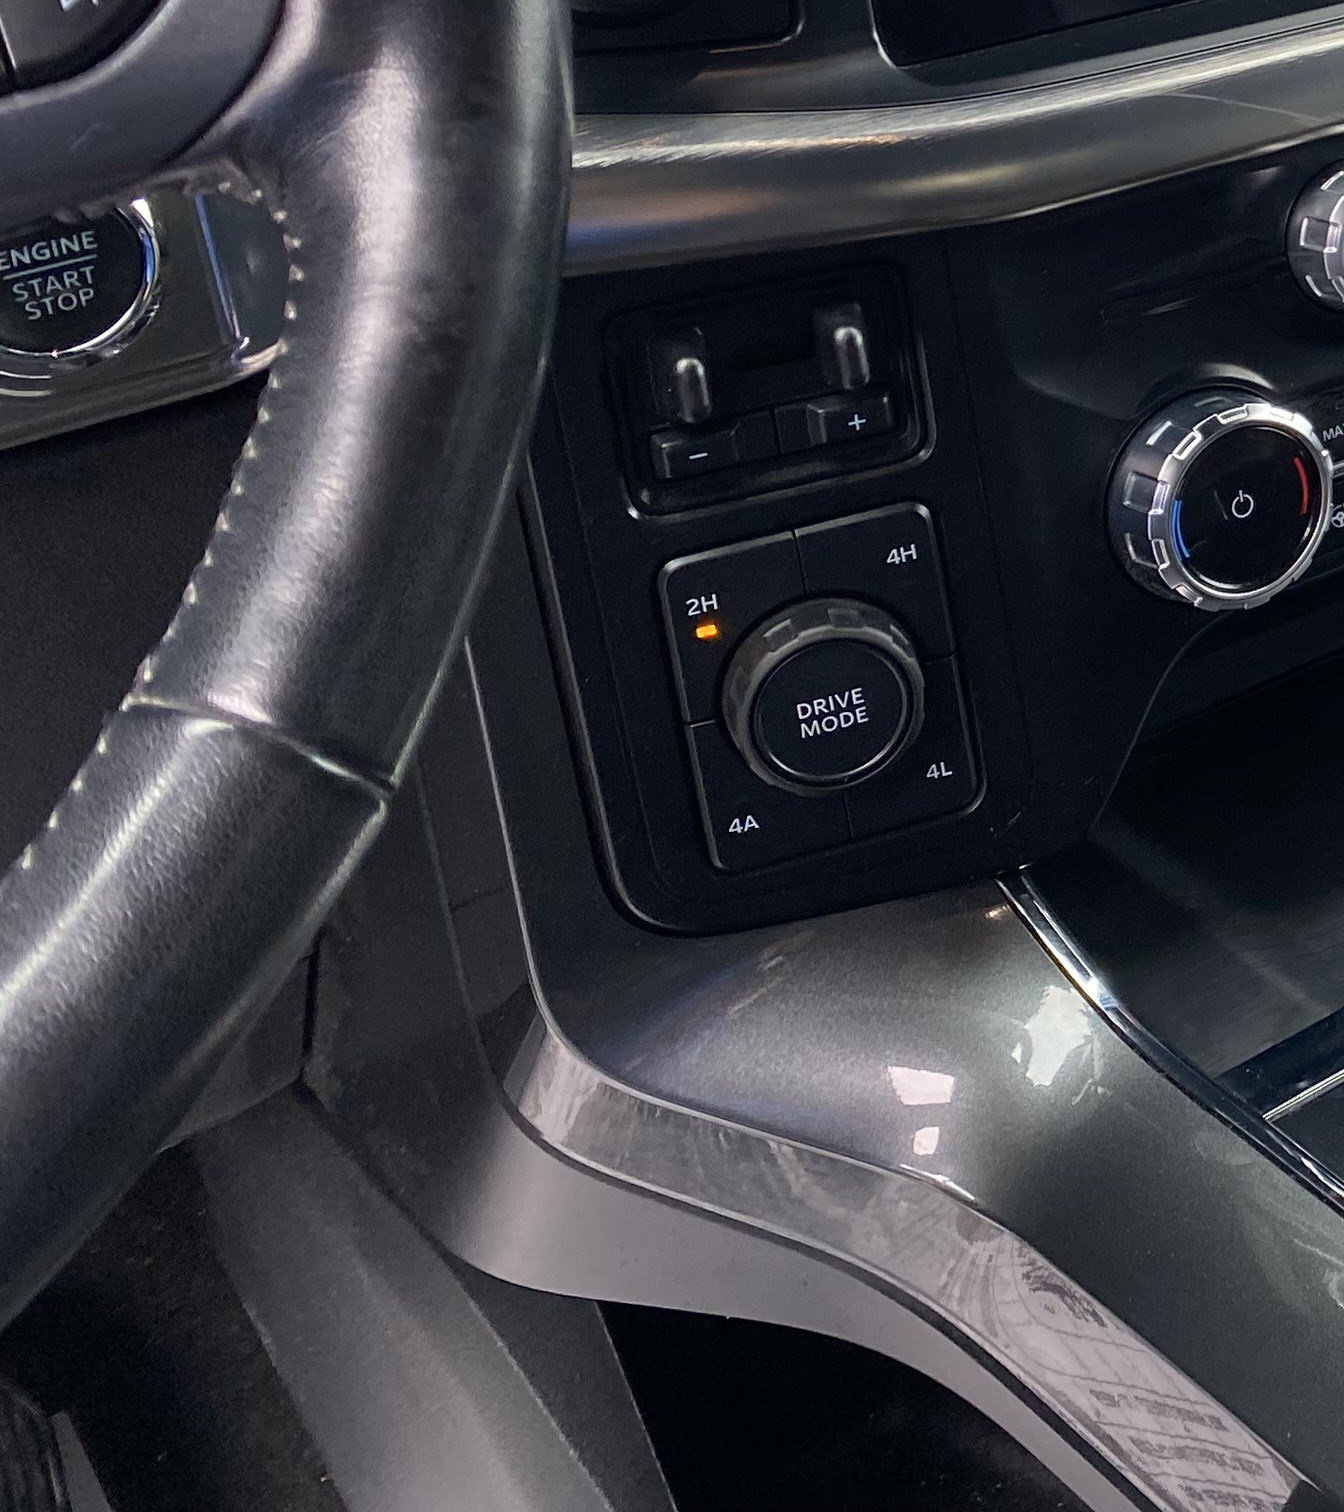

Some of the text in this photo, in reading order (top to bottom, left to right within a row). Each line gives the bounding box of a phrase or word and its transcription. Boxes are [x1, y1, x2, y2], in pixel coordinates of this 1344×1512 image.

[0, 230, 98, 270] ENGINE
[12, 265, 96, 303] START
[24, 288, 95, 321] STOP
[885, 543, 918, 567] 4H
[685, 593, 719, 617] 2H
[796, 687, 866, 721] DRIVE
[800, 706, 870, 739] MODE
[925, 761, 953, 781] 4L
[728, 813, 760, 836] 4A
